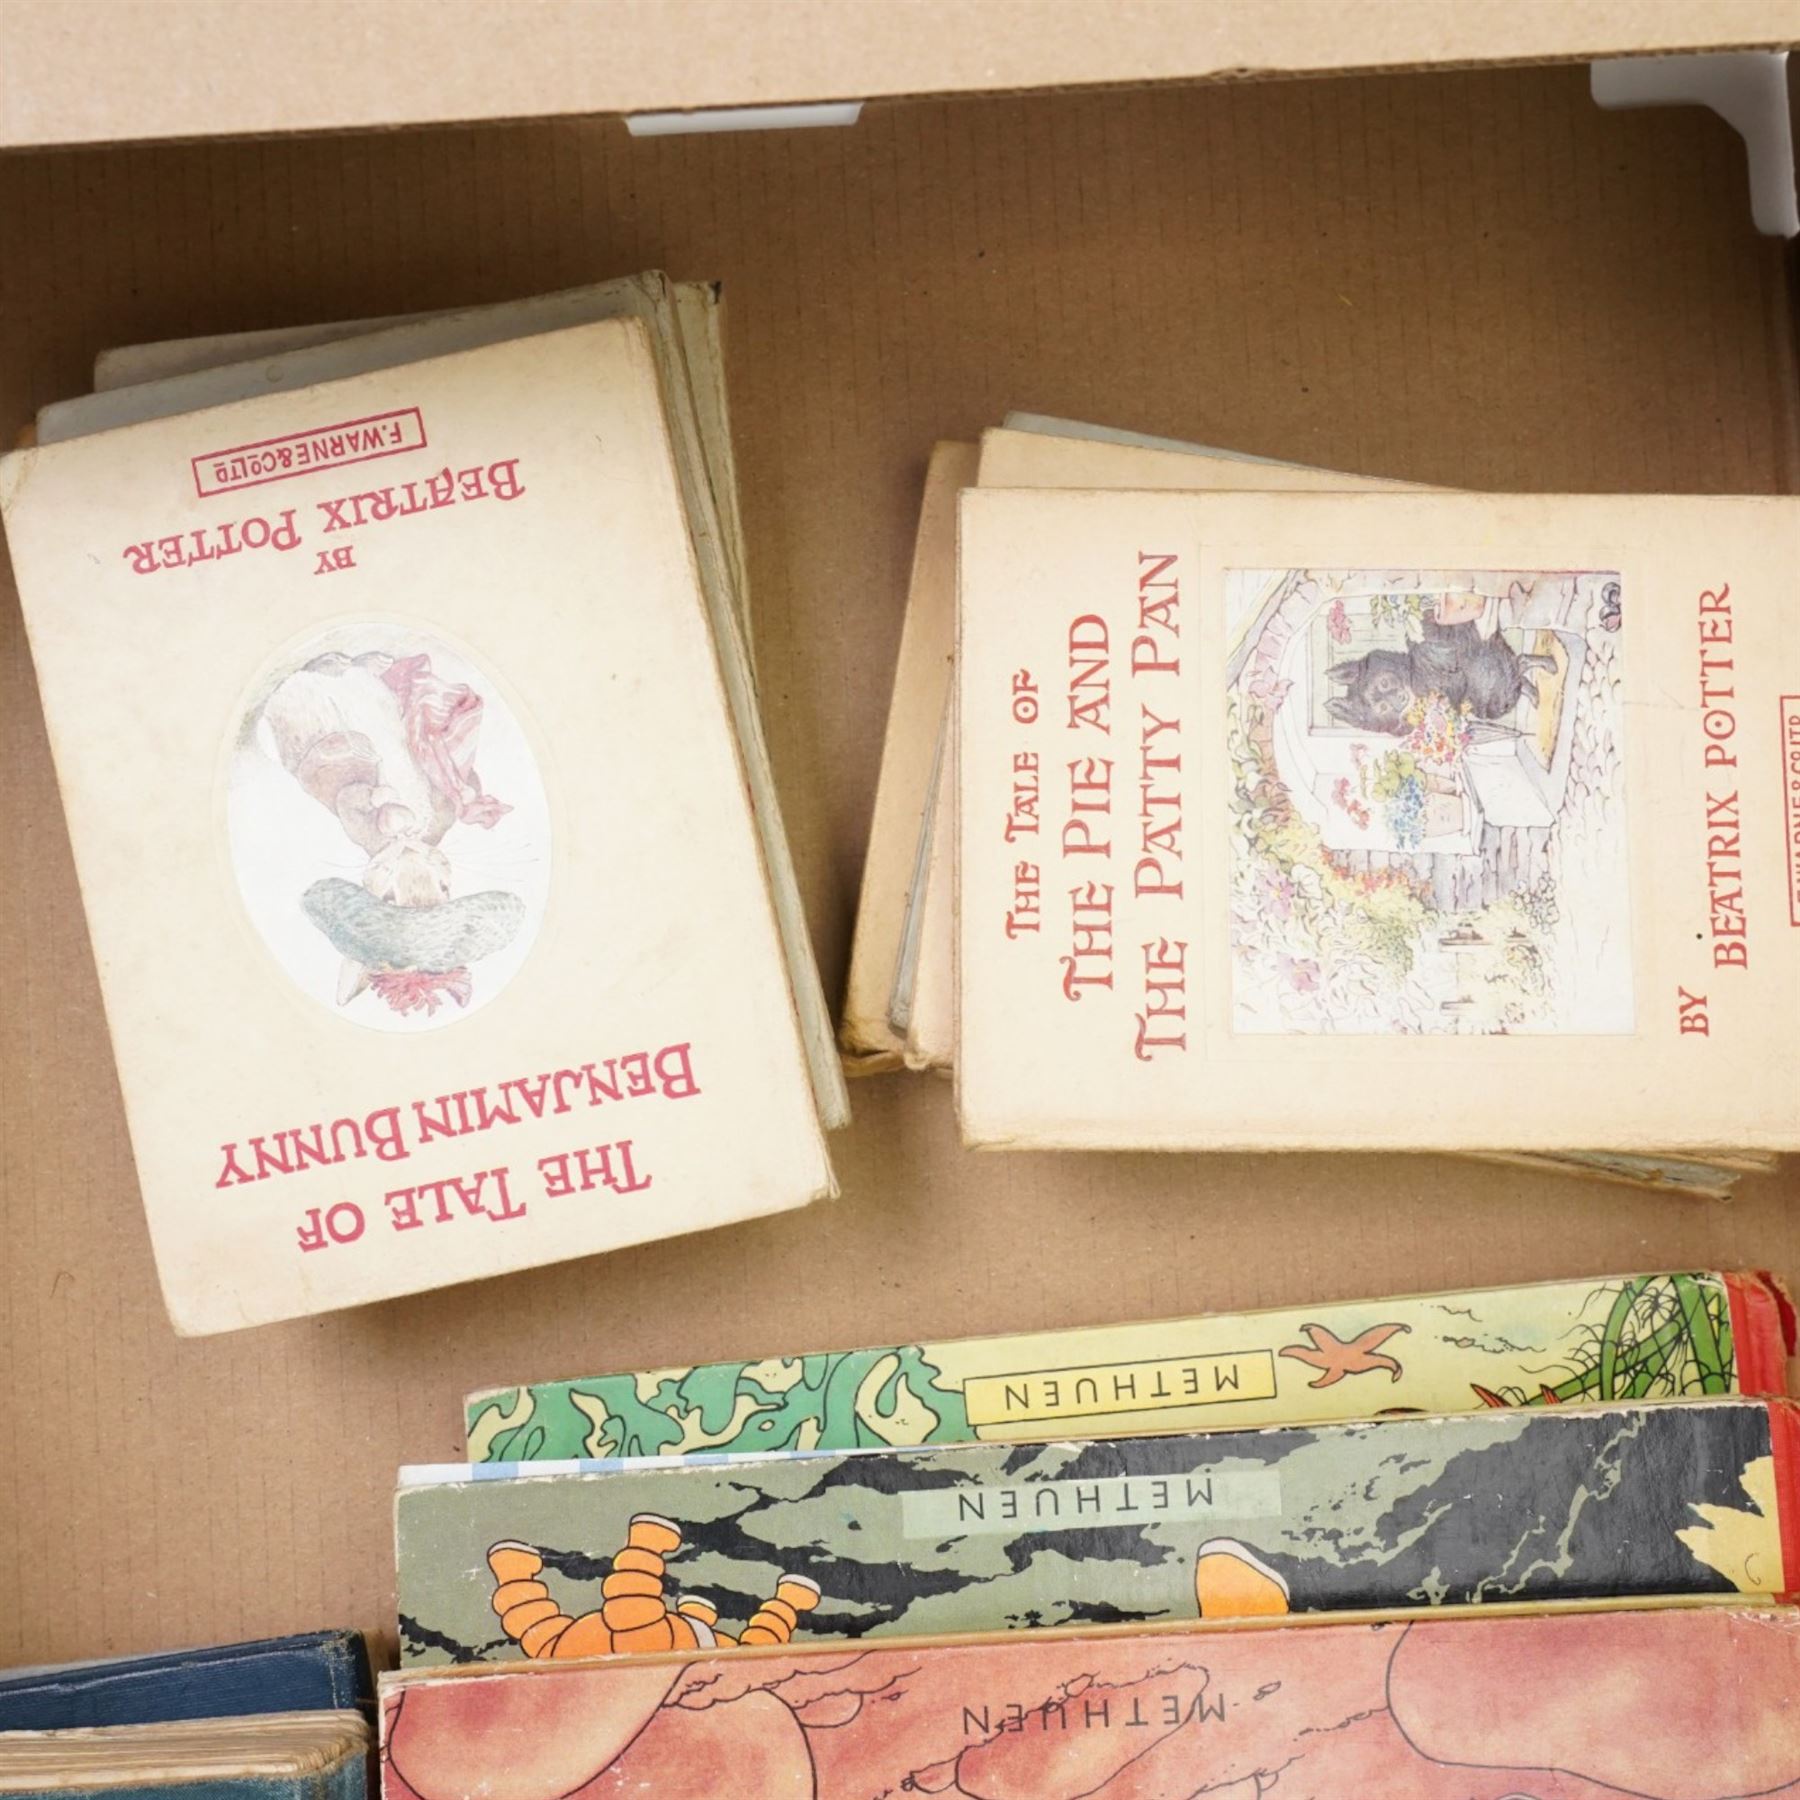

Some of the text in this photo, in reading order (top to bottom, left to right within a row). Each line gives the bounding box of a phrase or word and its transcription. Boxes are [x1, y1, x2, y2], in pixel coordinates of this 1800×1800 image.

[123, 459, 524, 575] BEATRIX POTTER
[314, 546, 357, 575] BY
[1005, 669, 1041, 940] THE TALE OF
[1059, 612, 1114, 1000] THE PIE AND
[1131, 551, 1187, 1063] THE PATTY PAN
[1698, 582, 1748, 970] BEATRIX POTTER
[1678, 986, 1710, 1036] BY
[215, 1042, 701, 1190] BENJAMIN BUNNY
[297, 1139, 651, 1253] THE TALE OF
[1005, 1364, 1239, 1411] METHUEN
[958, 1477, 1213, 1521] METHUEN
[962, 1693, 1226, 1736] METHUEN
